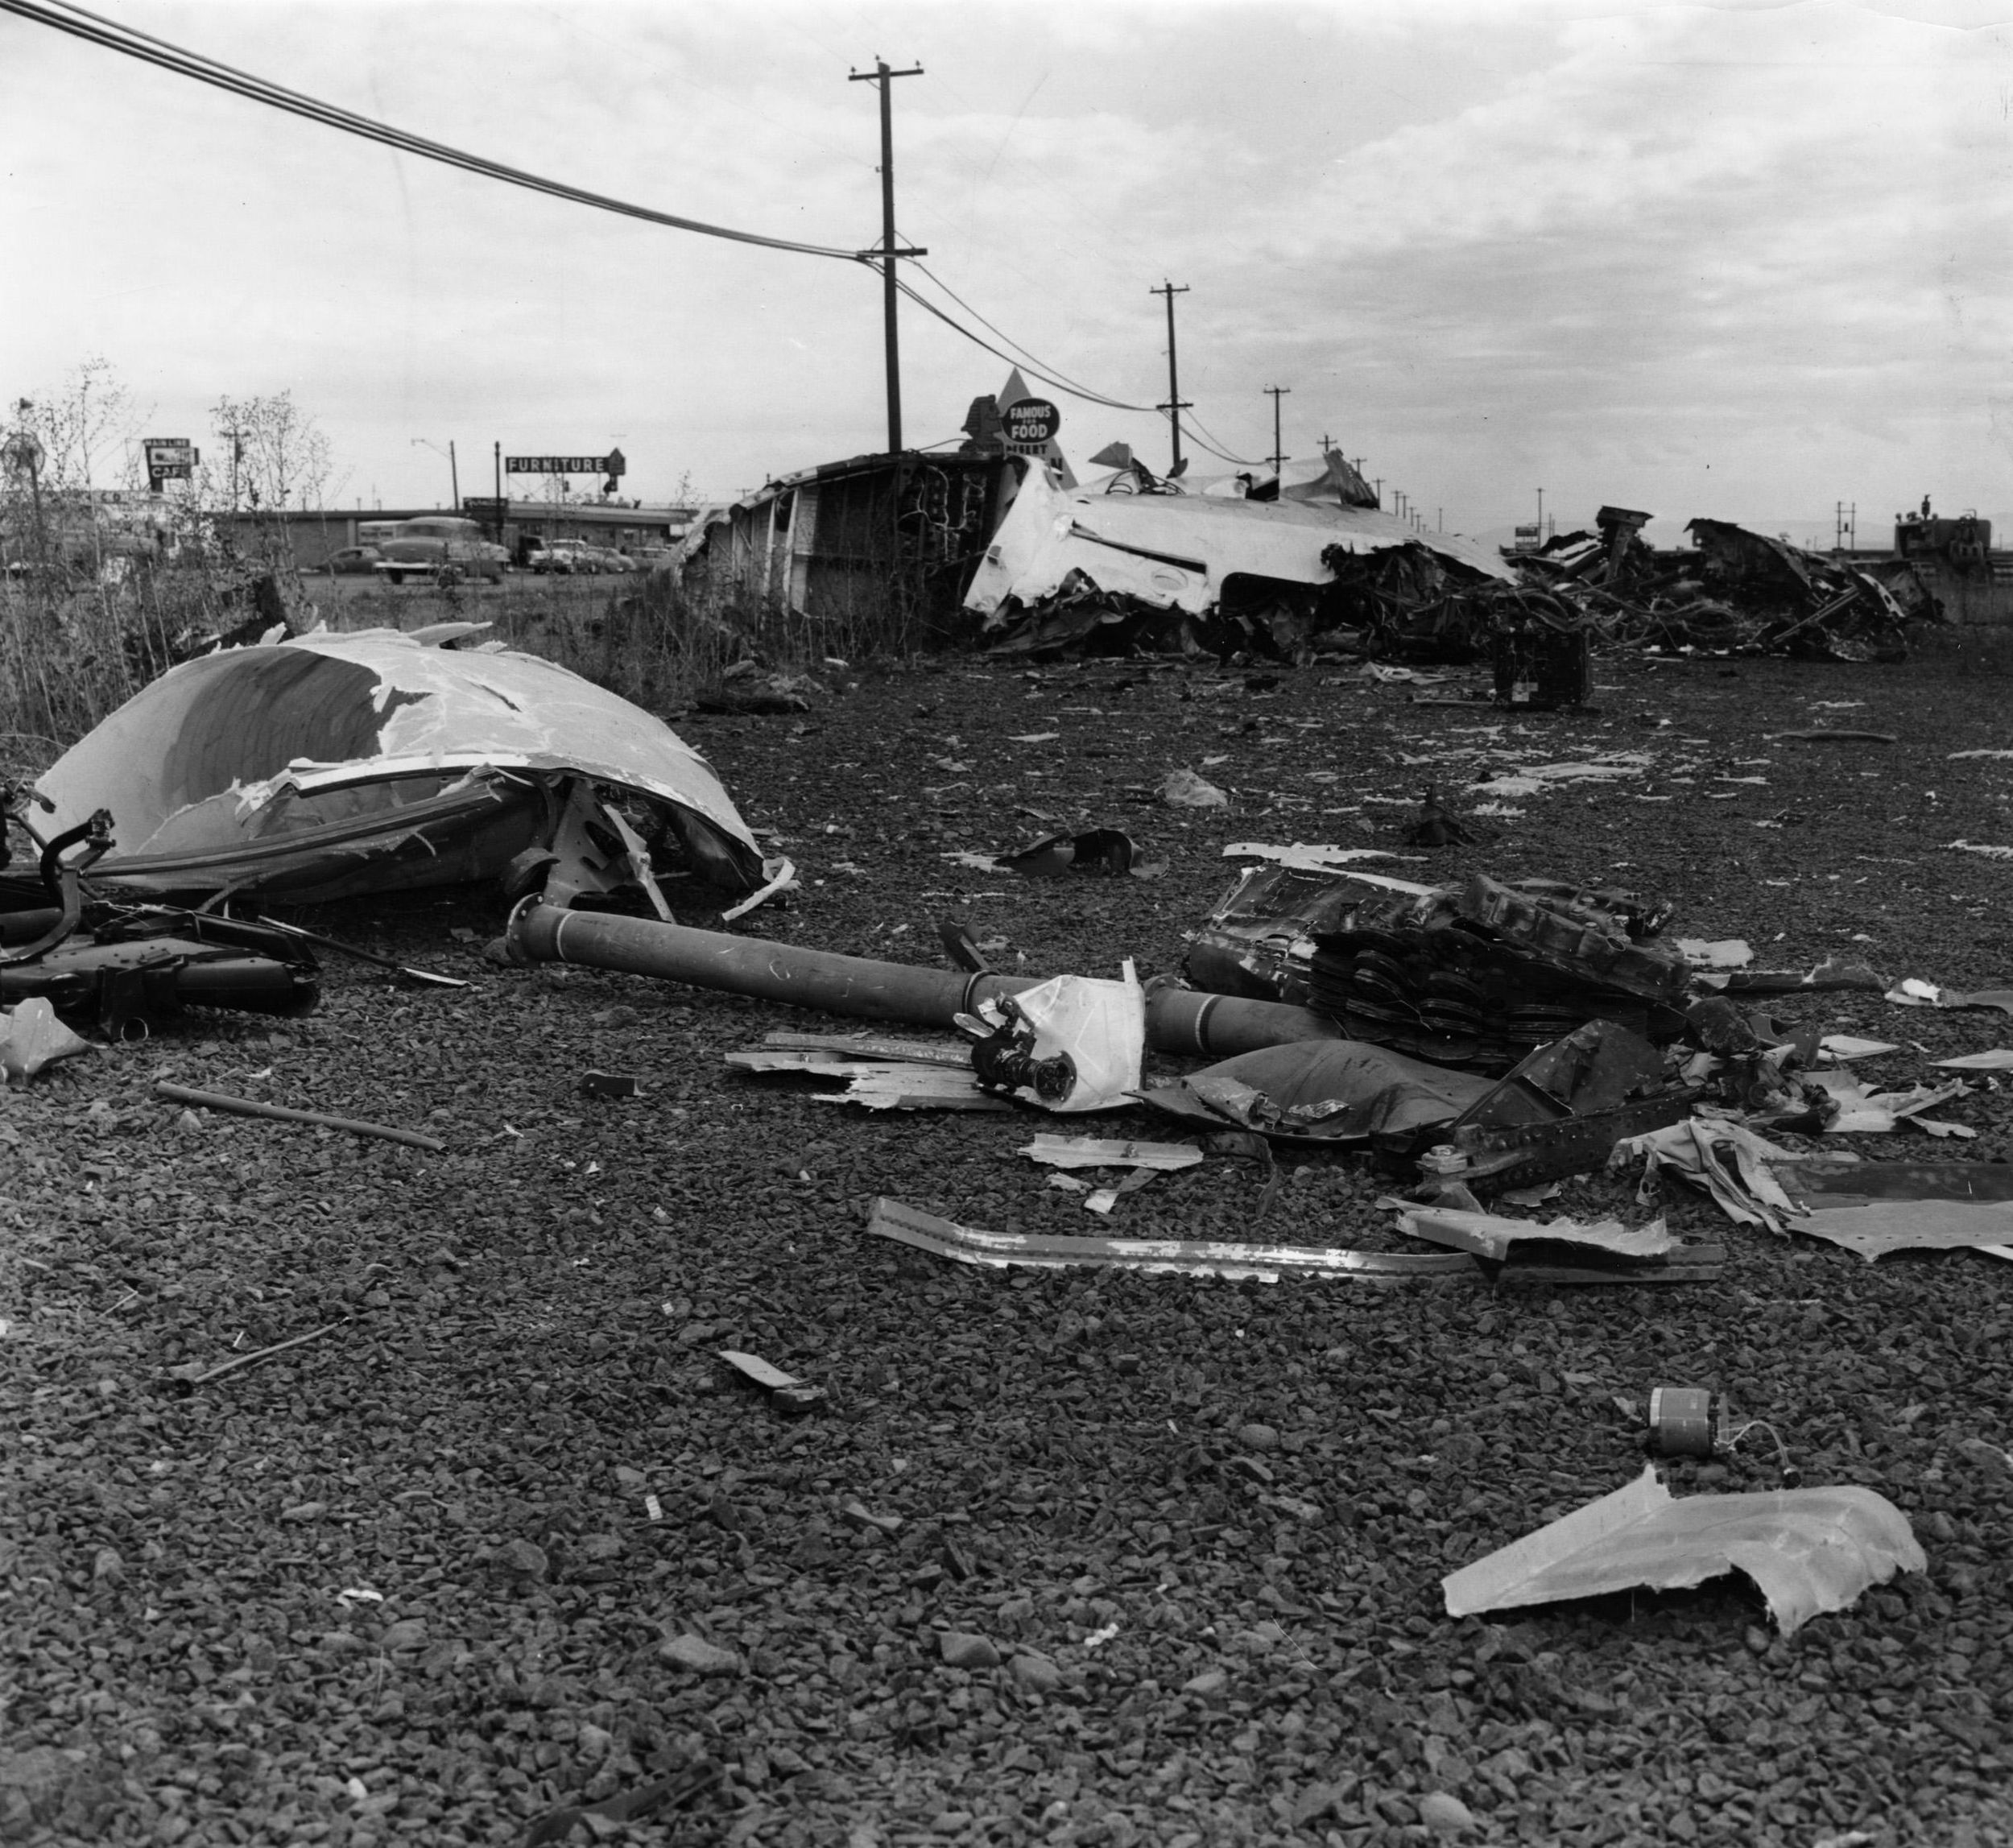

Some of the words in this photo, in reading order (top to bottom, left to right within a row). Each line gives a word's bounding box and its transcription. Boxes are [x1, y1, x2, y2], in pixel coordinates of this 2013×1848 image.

[1010, 406, 1051, 419] FAMOUS
[1011, 424, 1048, 439] FOOD
[508, 459, 604, 471] FURNITURE
